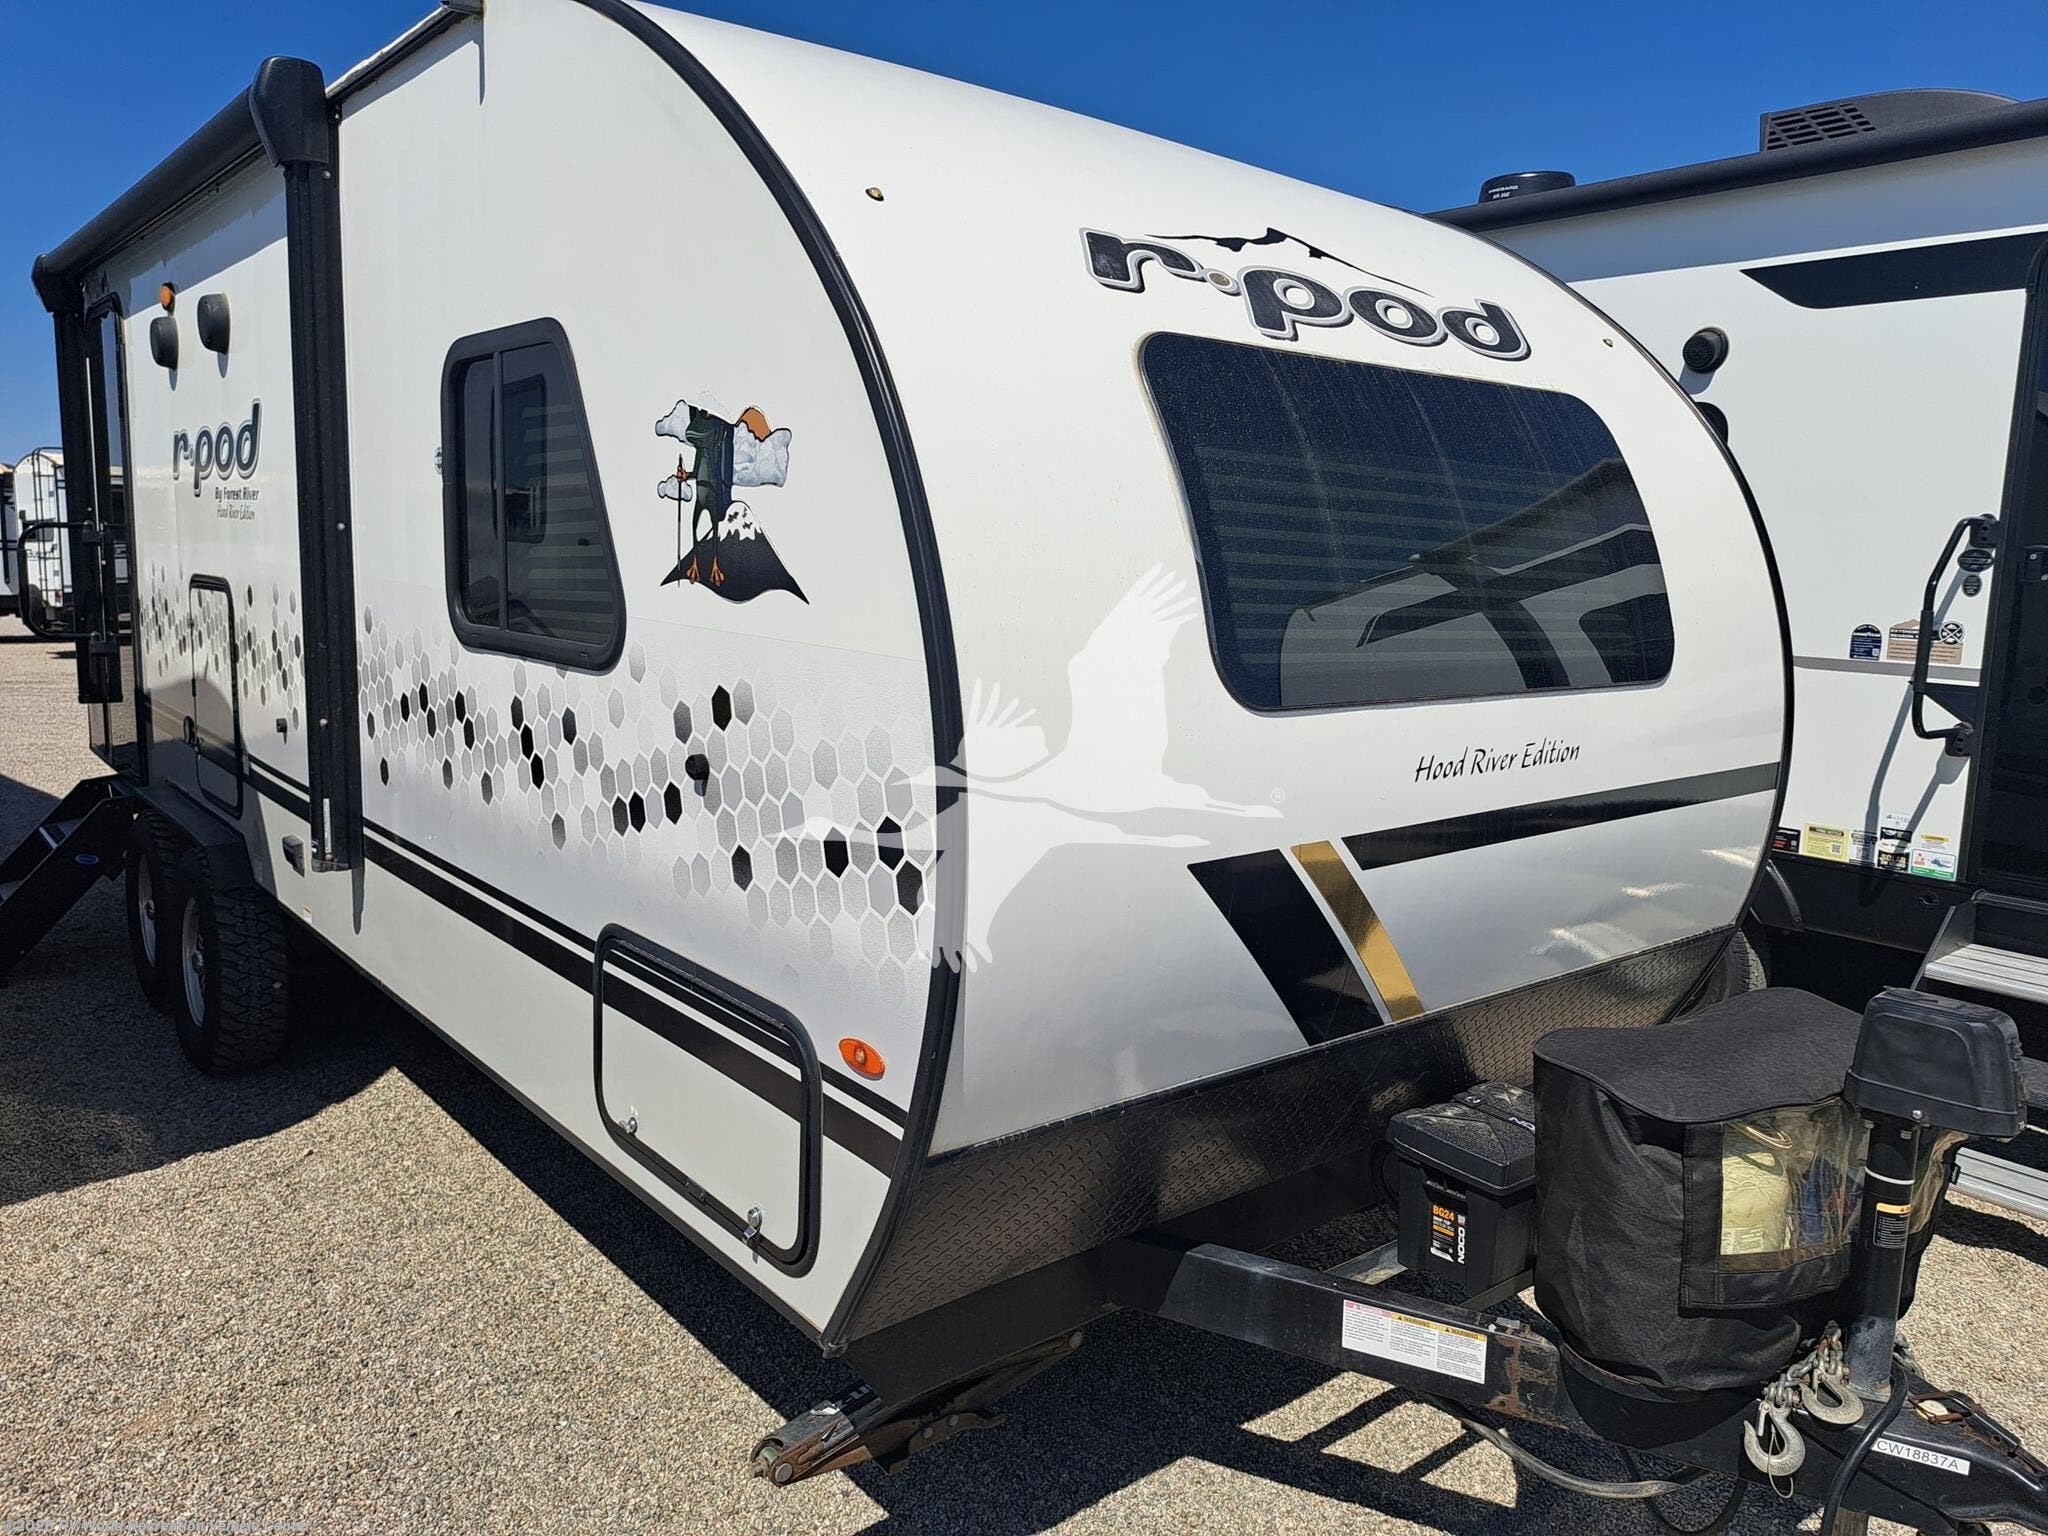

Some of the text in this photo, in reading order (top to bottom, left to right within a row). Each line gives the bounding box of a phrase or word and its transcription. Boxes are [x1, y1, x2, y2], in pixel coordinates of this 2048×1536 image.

[215, 486, 260, 503] By Forest River
[217, 503, 256, 521] Hood River Edition
[1414, 737, 1581, 783] Hood River Edition
[1432, 1204, 1455, 1221] BG24
[1457, 1226, 1466, 1265] NOCO
[1403, 1315, 1431, 1329] WARNING
[1450, 1327, 1479, 1340] WARNING
[1876, 1440, 1959, 1471] CW18837A
